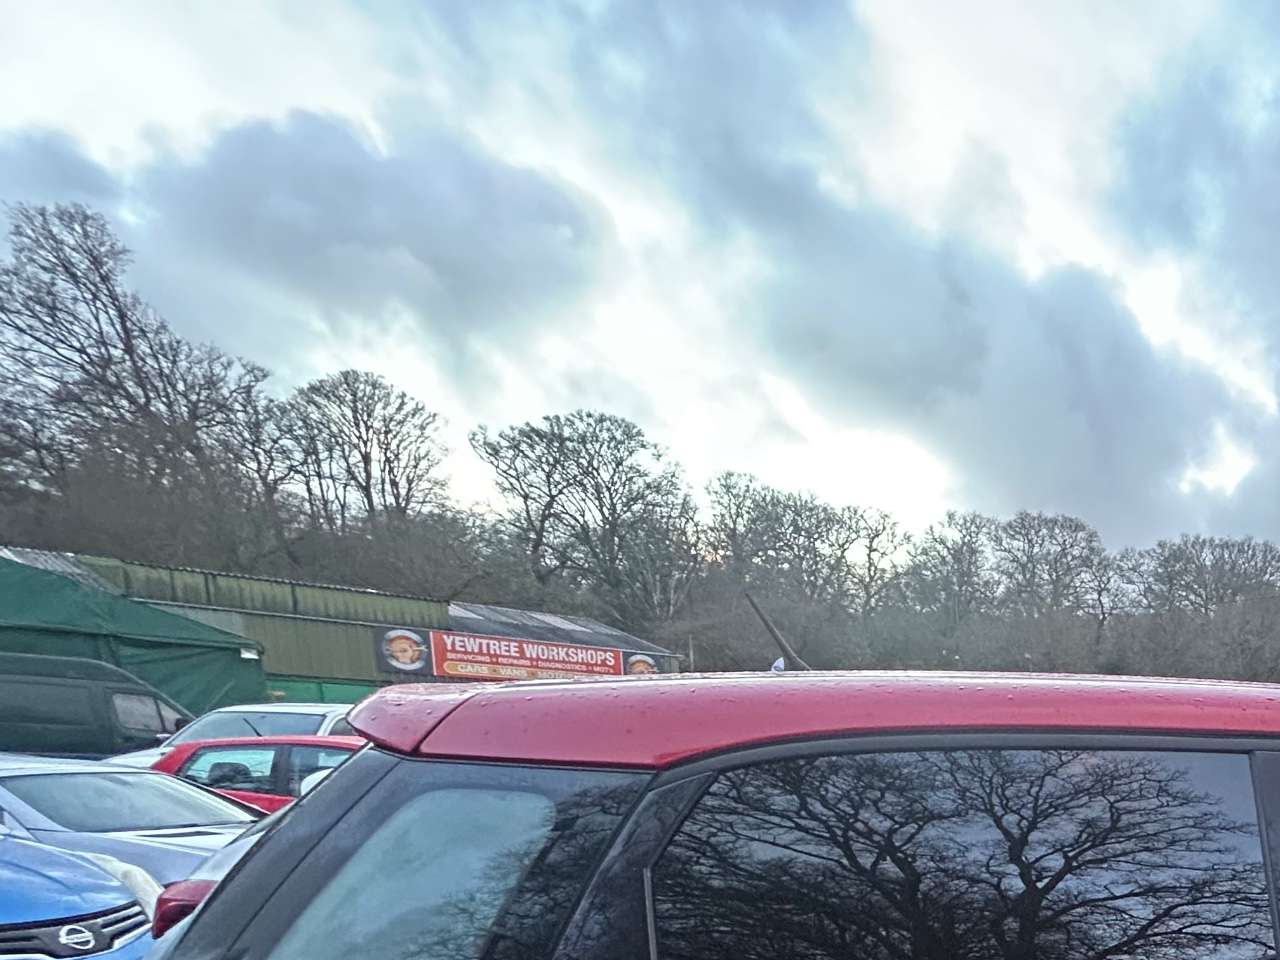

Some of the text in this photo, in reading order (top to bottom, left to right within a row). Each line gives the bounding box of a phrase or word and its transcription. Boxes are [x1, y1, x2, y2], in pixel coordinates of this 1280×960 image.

[443, 635, 615, 666] YEWTREE WORKSHOPS
[457, 664, 489, 673] CARS
[538, 661, 587, 671] DIAGNOSTICS
